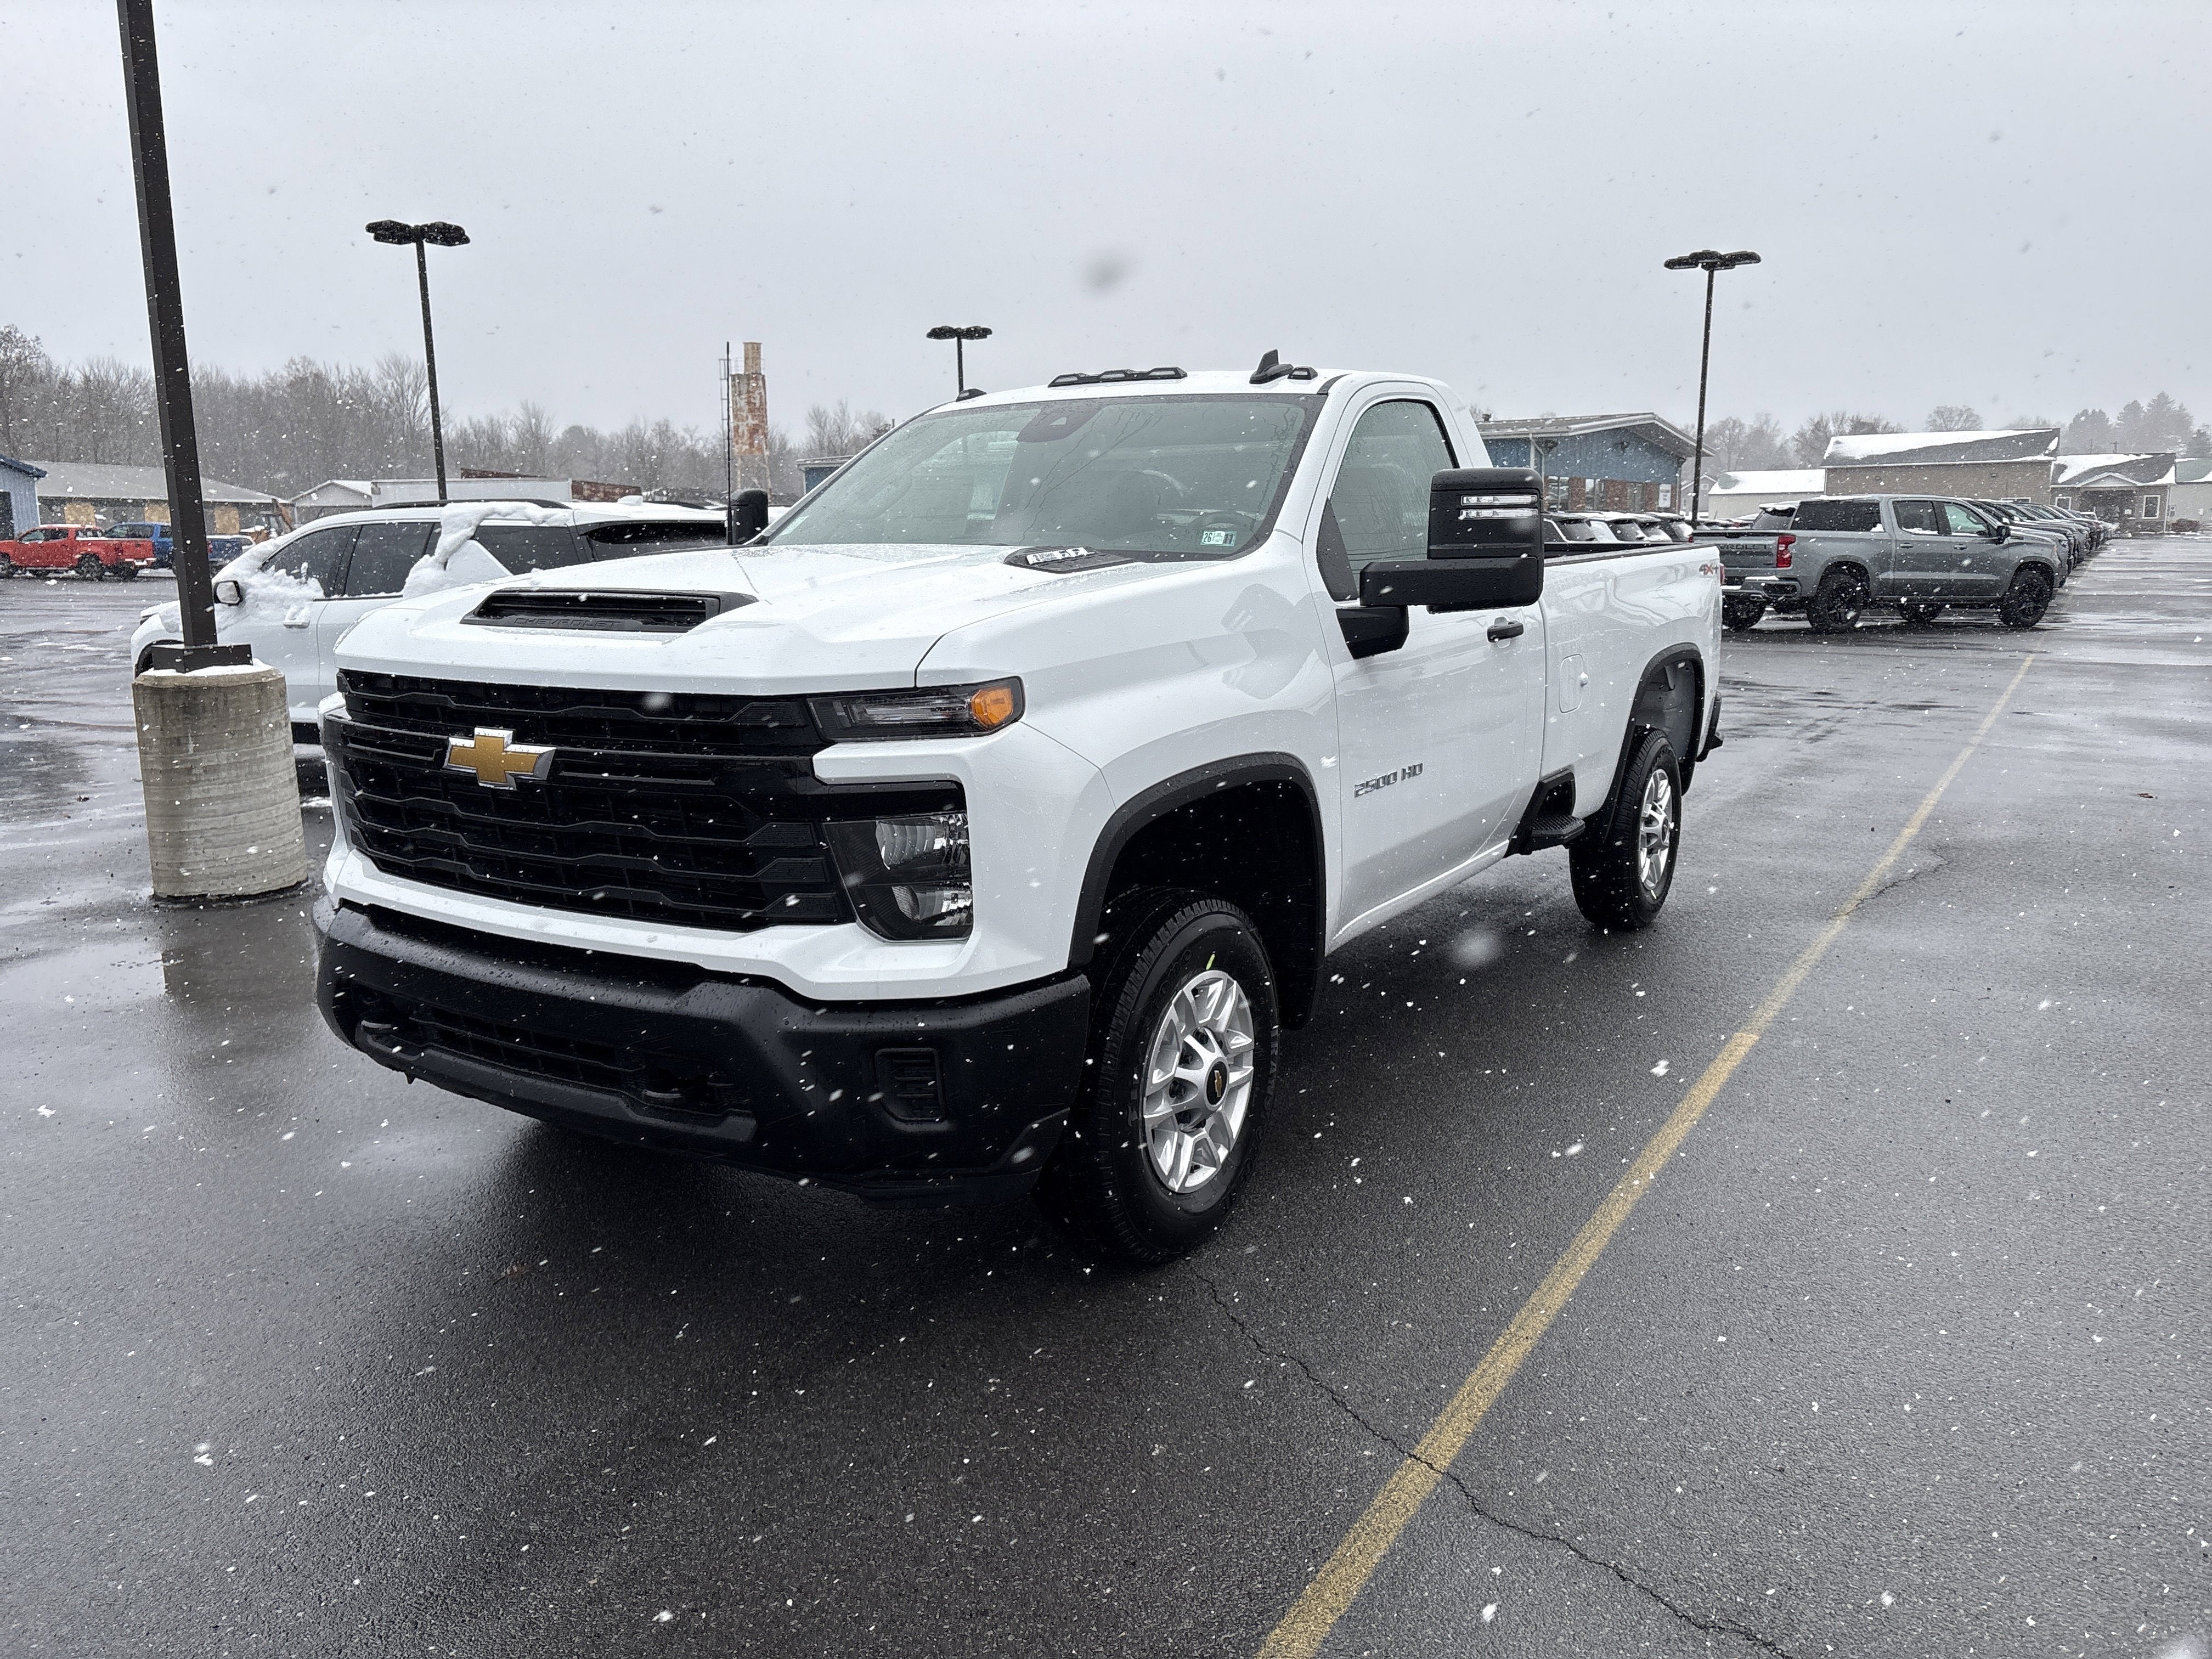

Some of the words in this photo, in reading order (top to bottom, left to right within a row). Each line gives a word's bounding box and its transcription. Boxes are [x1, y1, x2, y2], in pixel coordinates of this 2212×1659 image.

[1204, 532, 1212, 543] 26
[1354, 770, 1398, 798] 2500
[1401, 762, 1423, 781] HD
